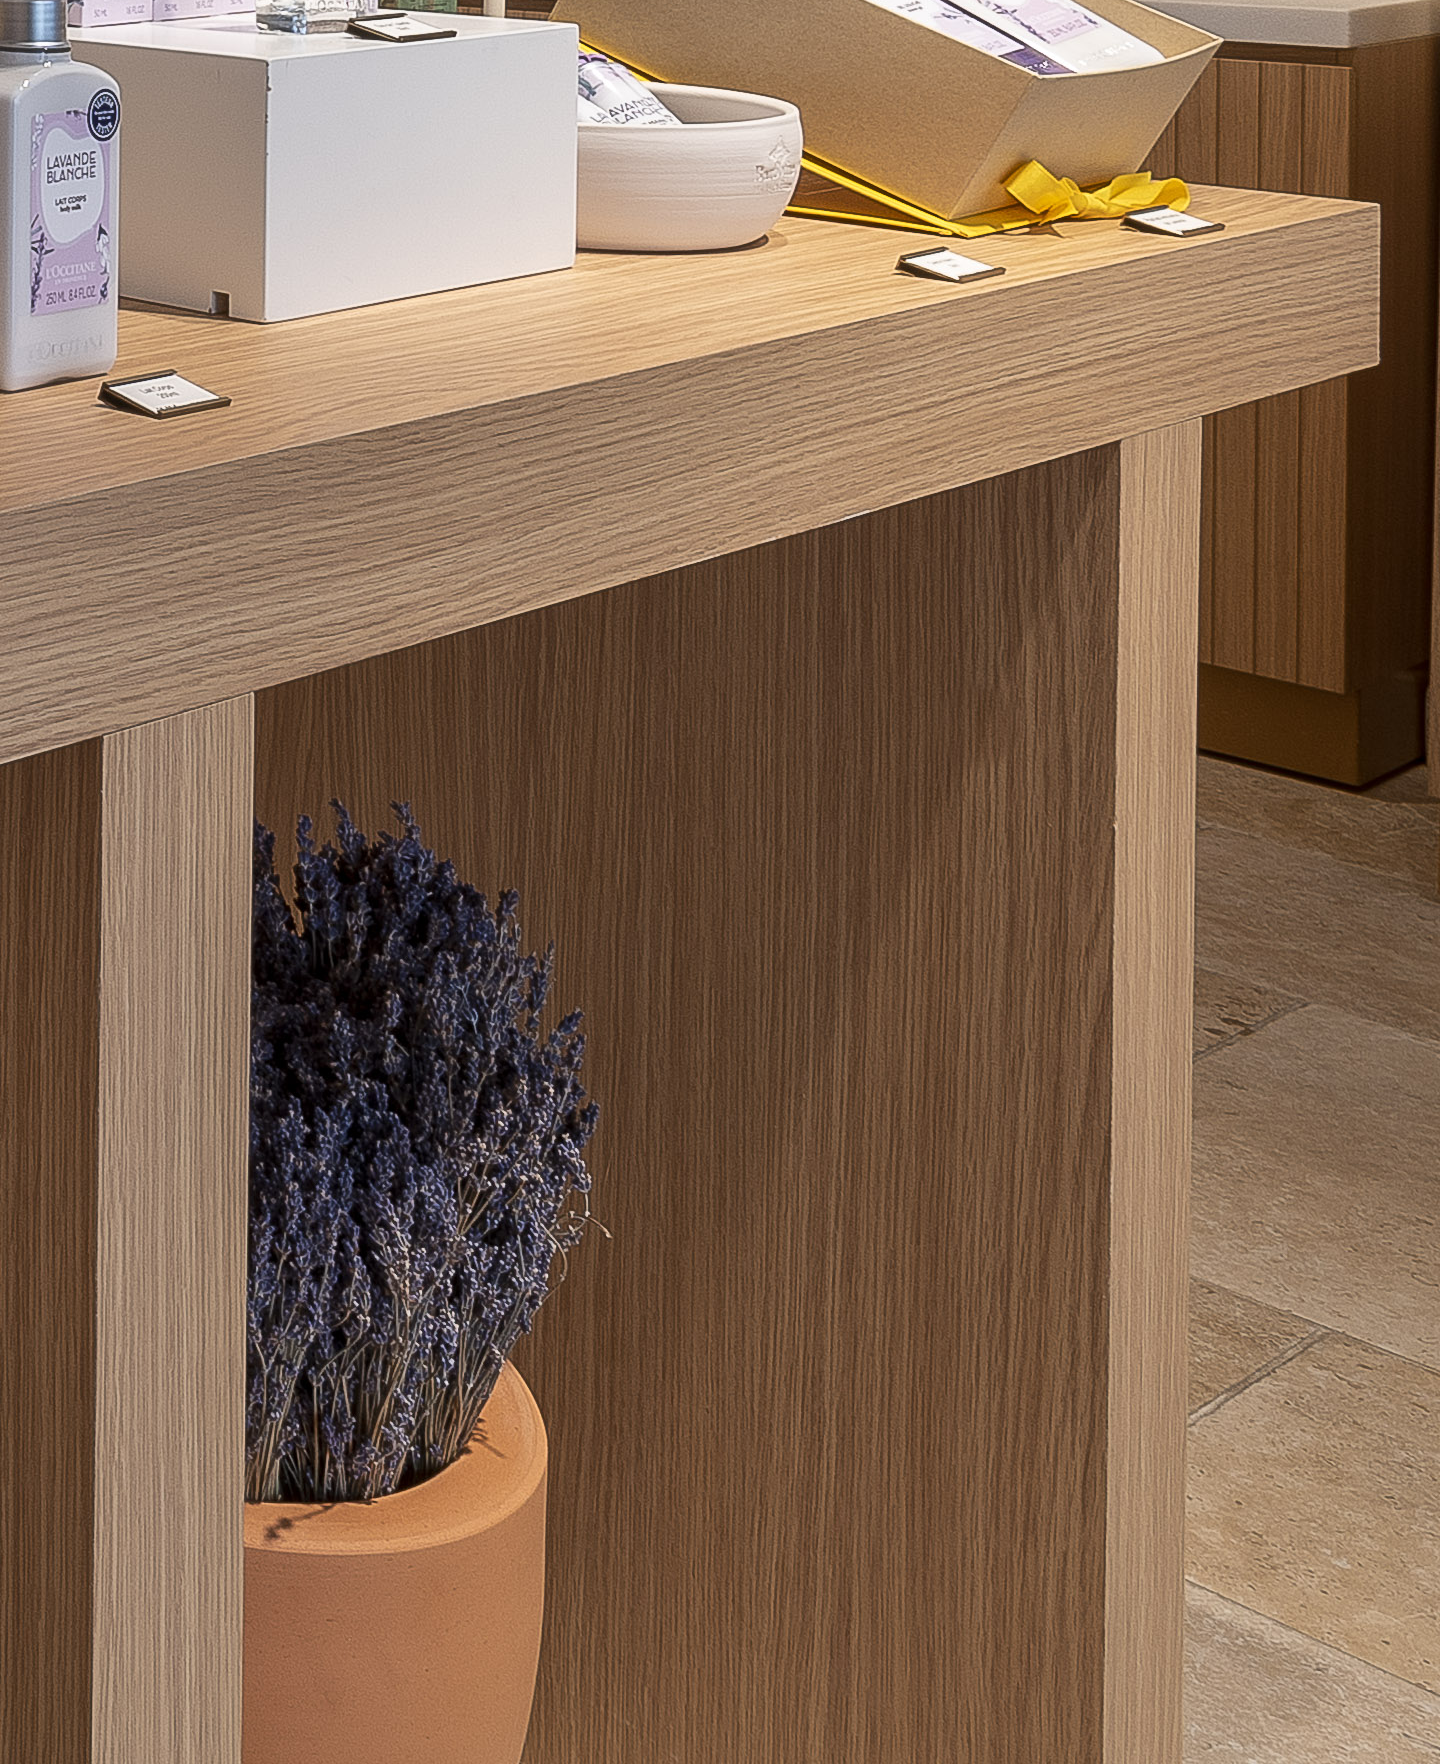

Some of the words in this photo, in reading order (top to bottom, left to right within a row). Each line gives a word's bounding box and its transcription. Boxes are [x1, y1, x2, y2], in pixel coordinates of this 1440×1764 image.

[46, 150, 97, 170] LAVANDE
[46, 164, 97, 185] BLANCHE
[55, 196, 67, 207] LAIT
[68, 194, 87, 206] CORPS
[45, 261, 98, 281] L'OCCITANE
[45, 292, 57, 306] 250
[58, 291, 67, 304] ML
